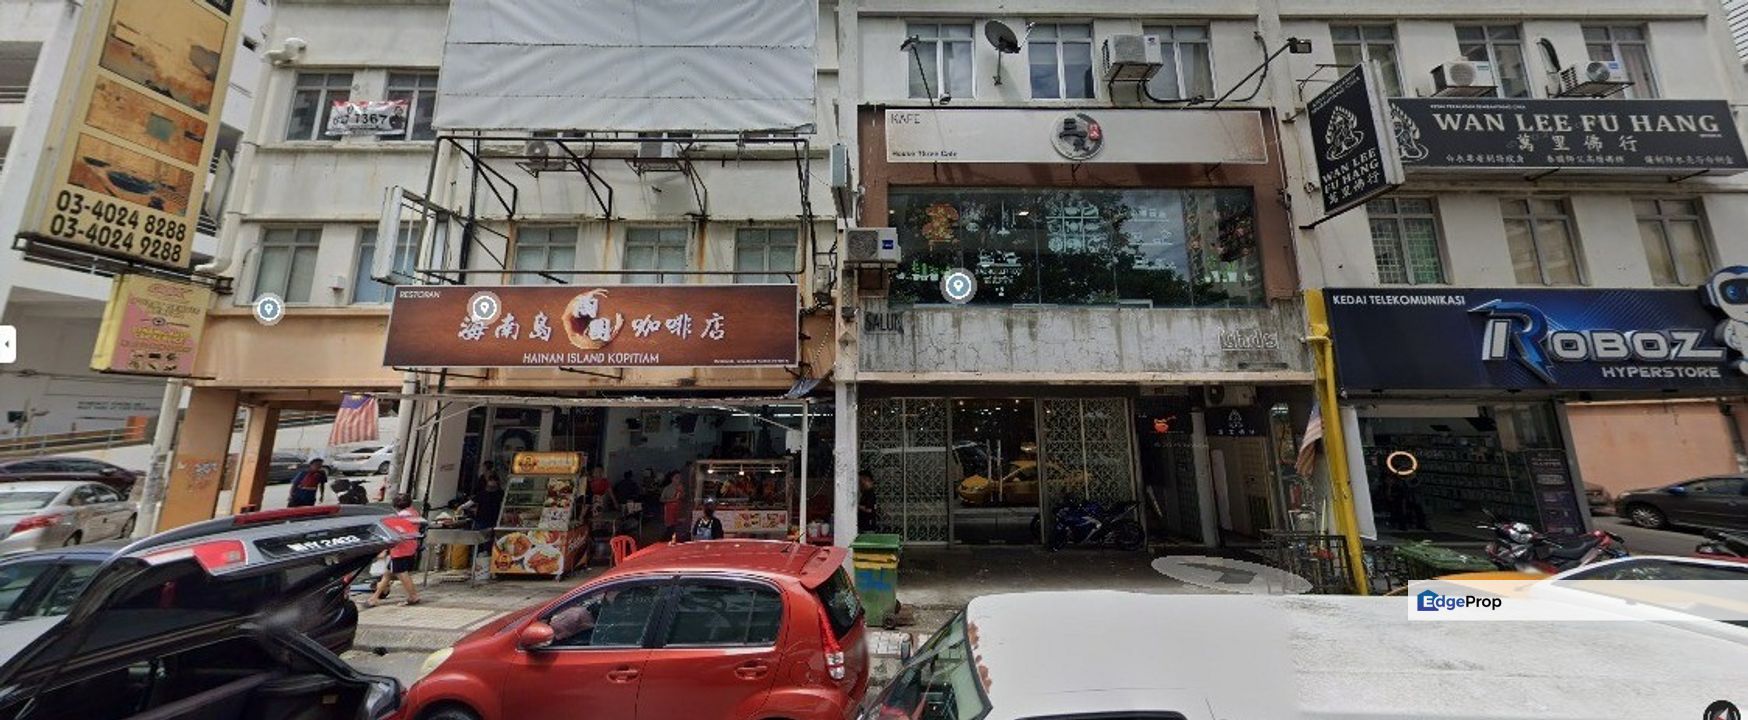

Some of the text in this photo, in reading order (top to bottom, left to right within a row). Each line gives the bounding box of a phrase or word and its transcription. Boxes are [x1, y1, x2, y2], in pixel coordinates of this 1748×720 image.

[891, 113, 920, 124] KAFE
[1432, 113, 1720, 133] WAN LEE FU HANG
[1322, 147, 1376, 183] WAN LEE
[1324, 158, 1379, 194] FU HANG
[56, 189, 187, 242] 03-4024 8288
[51, 213, 182, 262] 03-4024 9288
[399, 290, 440, 299] RESTORAN
[1332, 295, 1466, 306] KEDAI TELEKOMUNIKASI
[631, 312, 726, 341] 咖啡店
[522, 352, 660, 364] HAINAN ISLAND KOPITIAM
[1601, 366, 1722, 379] HYPERSTORE
